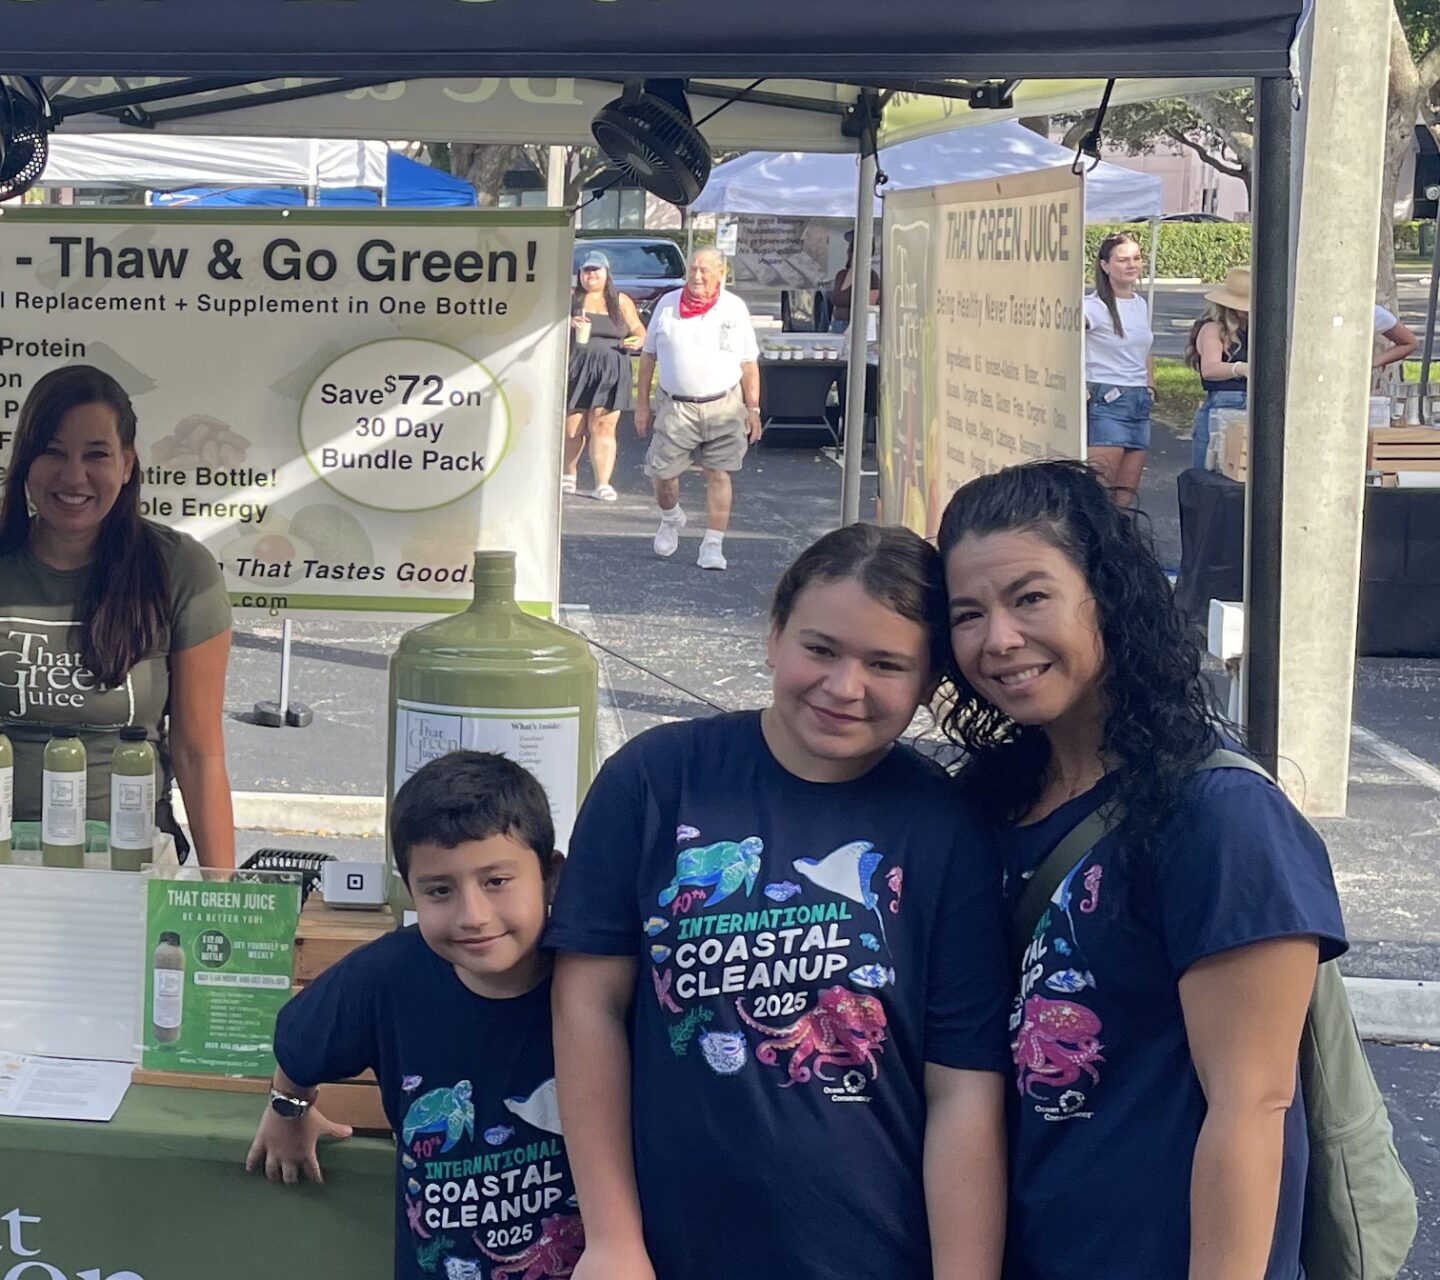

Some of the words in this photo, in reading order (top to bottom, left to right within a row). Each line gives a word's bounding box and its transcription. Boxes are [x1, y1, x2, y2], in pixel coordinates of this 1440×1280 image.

[946, 209, 976, 260] THAT
[977, 206, 1023, 261] GREEN
[1024, 202, 1069, 262] JUICE
[49, 236, 189, 279] Thaw
[207, 238, 243, 281] &
[262, 238, 338, 282] Go
[357, 239, 538, 284] Green!
[15, 291, 166, 314] Replacement
[175, 298, 188, 311] +
[197, 294, 339, 317] Supplement
[348, 295, 369, 315] in
[379, 296, 426, 315] One
[436, 297, 508, 316] Bottle
[936, 288, 955, 323] Being
[985, 292, 1007, 323] Never
[1010, 294, 1037, 327] Tasted
[1039, 296, 1051, 329] So
[320, 383, 384, 405] Save
[449, 389, 482, 407] on
[355, 417, 386, 438] 30
[395, 417, 444, 444] Day
[322, 448, 413, 470] Bundle
[422, 450, 485, 472] Pack
[140, 467, 186, 486] tire
[196, 467, 277, 487] Bottle!
[182, 498, 268, 524] Energy
[235, 558, 291, 579] That
[303, 560, 386, 582] Tastes
[8, 630, 83, 667] That
[8, 670, 85, 717] Juice
[409, 728, 458, 751] Green
[414, 718, 443, 738] That
[167, 889, 199, 907] THAT
[201, 891, 240, 908] GREEN
[242, 893, 276, 910] JUICE
[677, 901, 852, 940] INTERNATIONAL
[675, 923, 850, 969] COASTAL
[675, 953, 848, 999] CLEANUP
[753, 991, 808, 1018] 2025
[424, 1138, 562, 1180] INTERNATIONAL
[424, 1160, 563, 1204] COASTAL
[424, 1187, 563, 1229] CLEANUP
[486, 1223, 533, 1248] 2025
